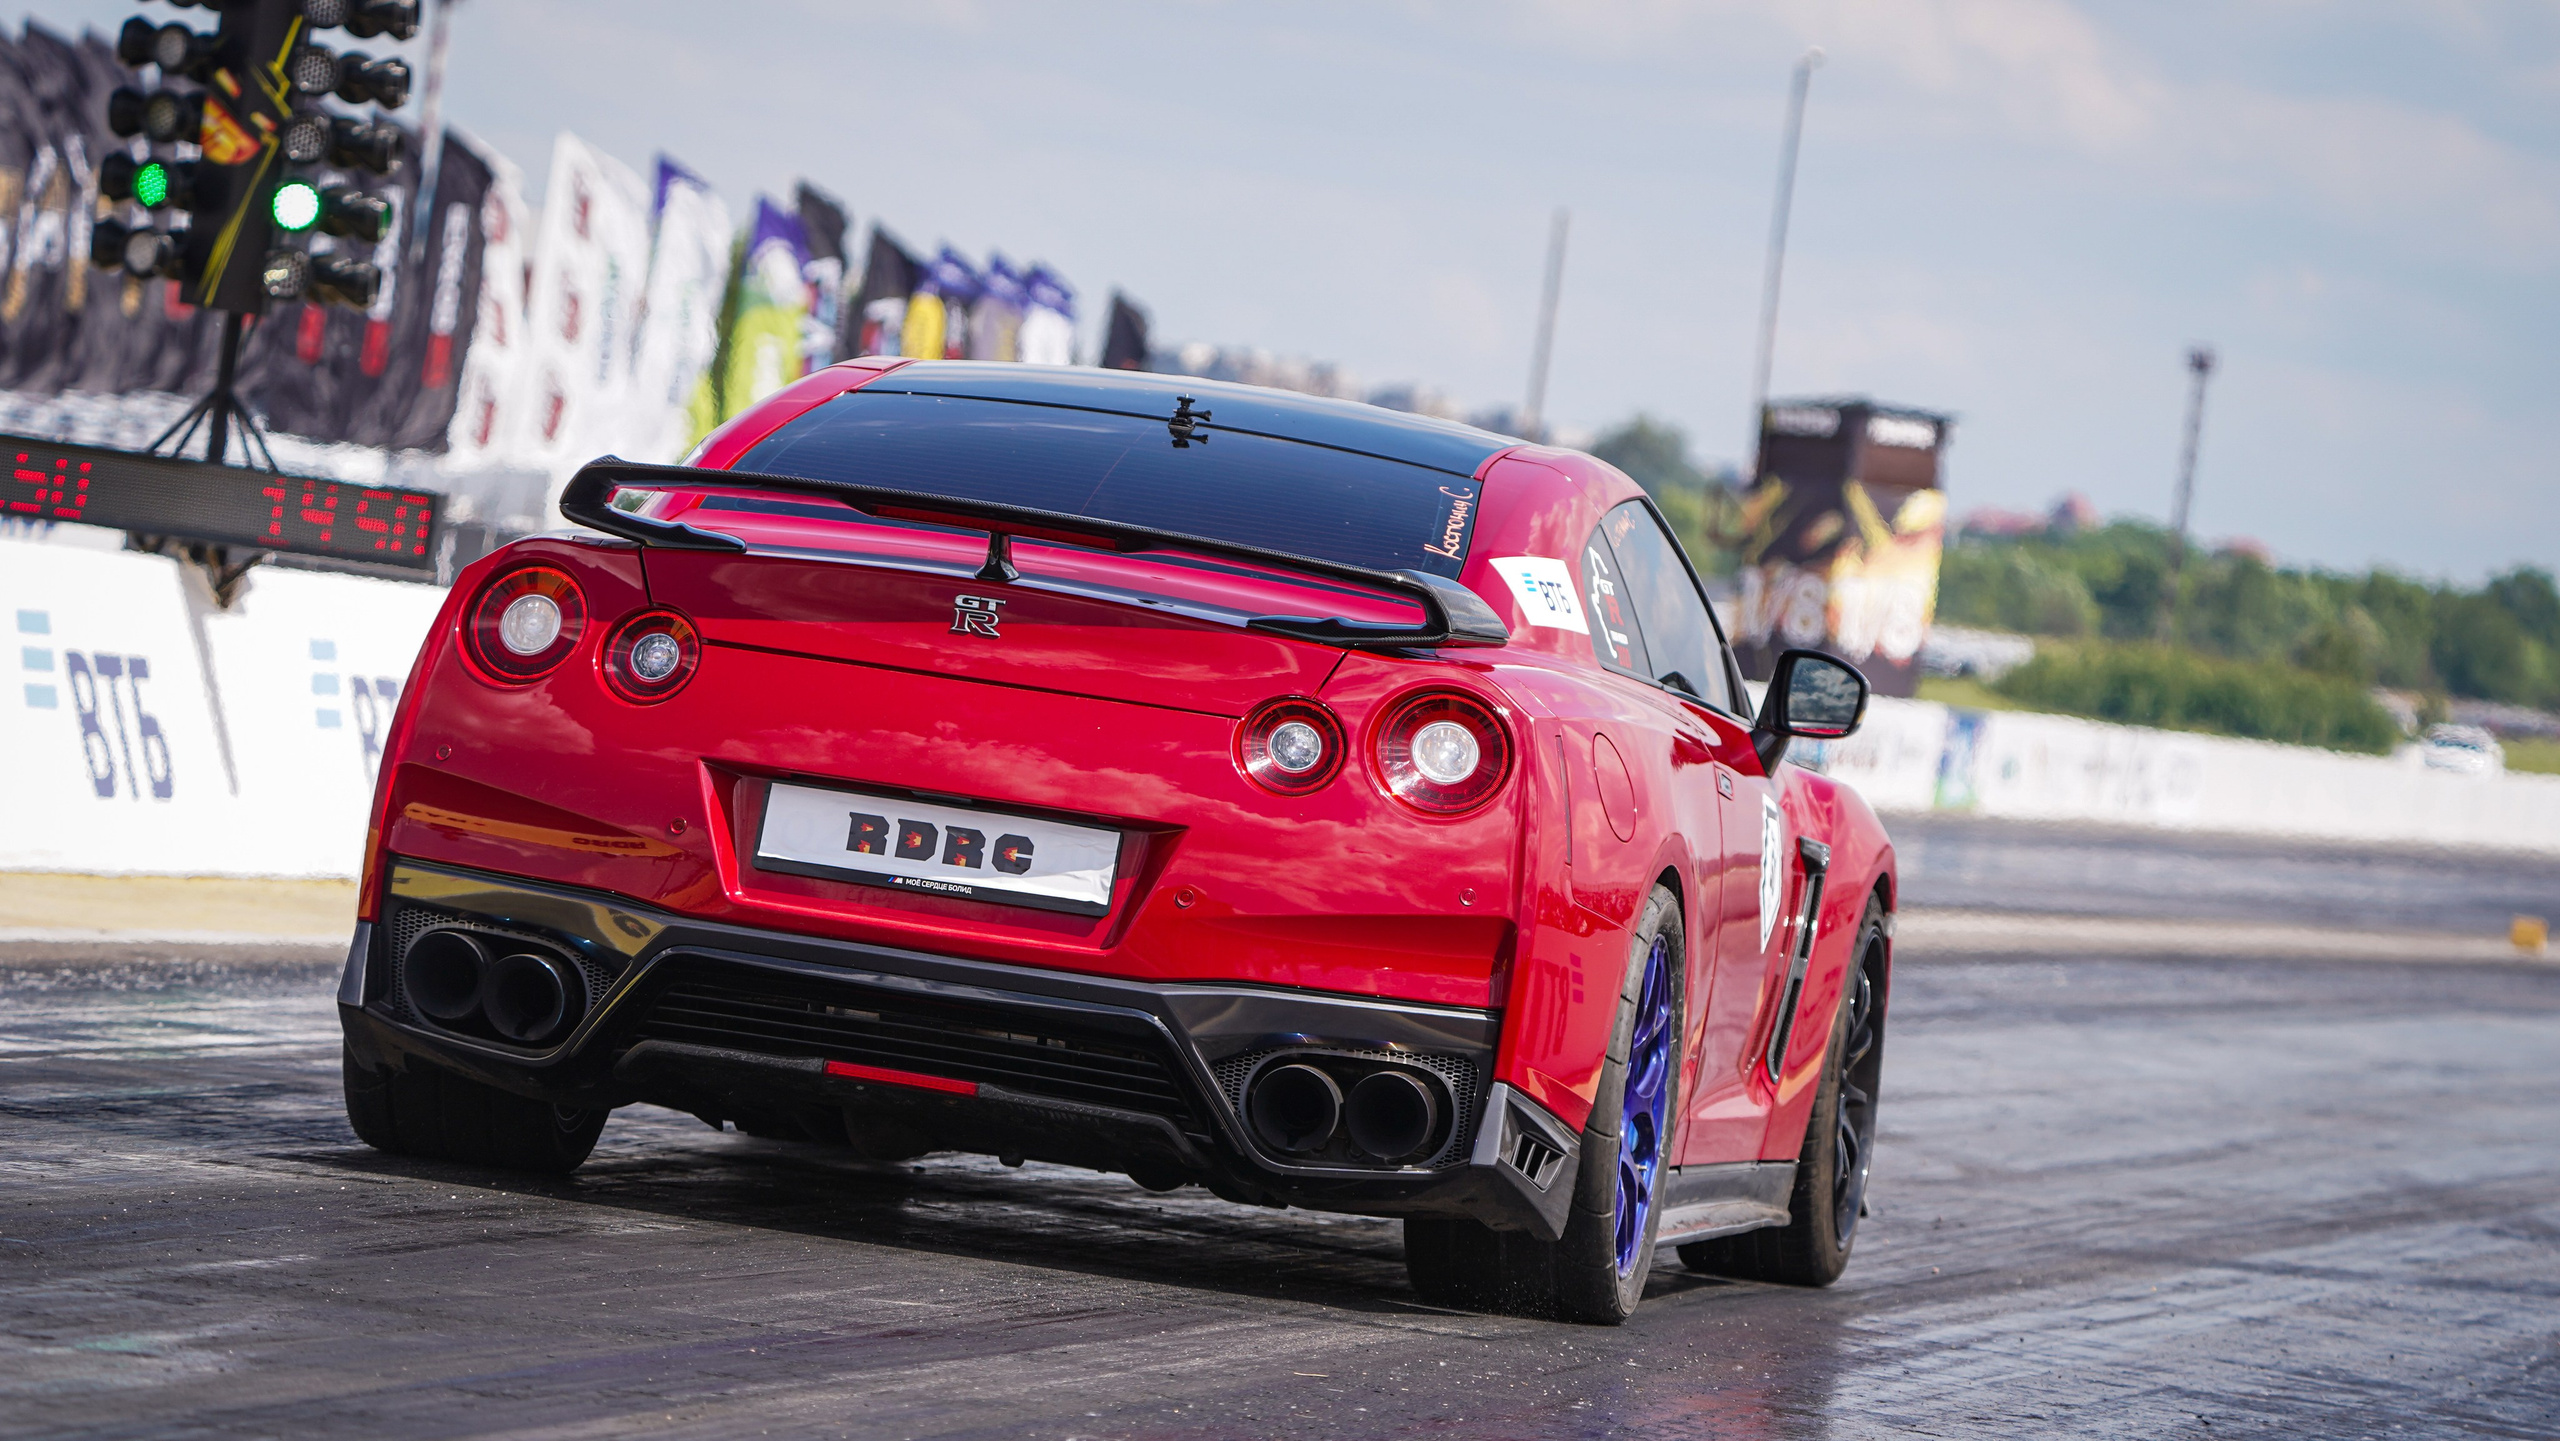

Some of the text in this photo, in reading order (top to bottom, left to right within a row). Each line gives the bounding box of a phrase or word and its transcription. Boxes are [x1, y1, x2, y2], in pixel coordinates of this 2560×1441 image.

[954, 594, 1006, 612] GT
[1538, 580, 1571, 614] ВТБ
[950, 607, 1001, 638] R
[65, 650, 174, 801] ВТБ
[846, 812, 1034, 875] RDRC
[922, 881, 947, 890] СЕРДЦЕ
[949, 885, 971, 894] БОЛИД
